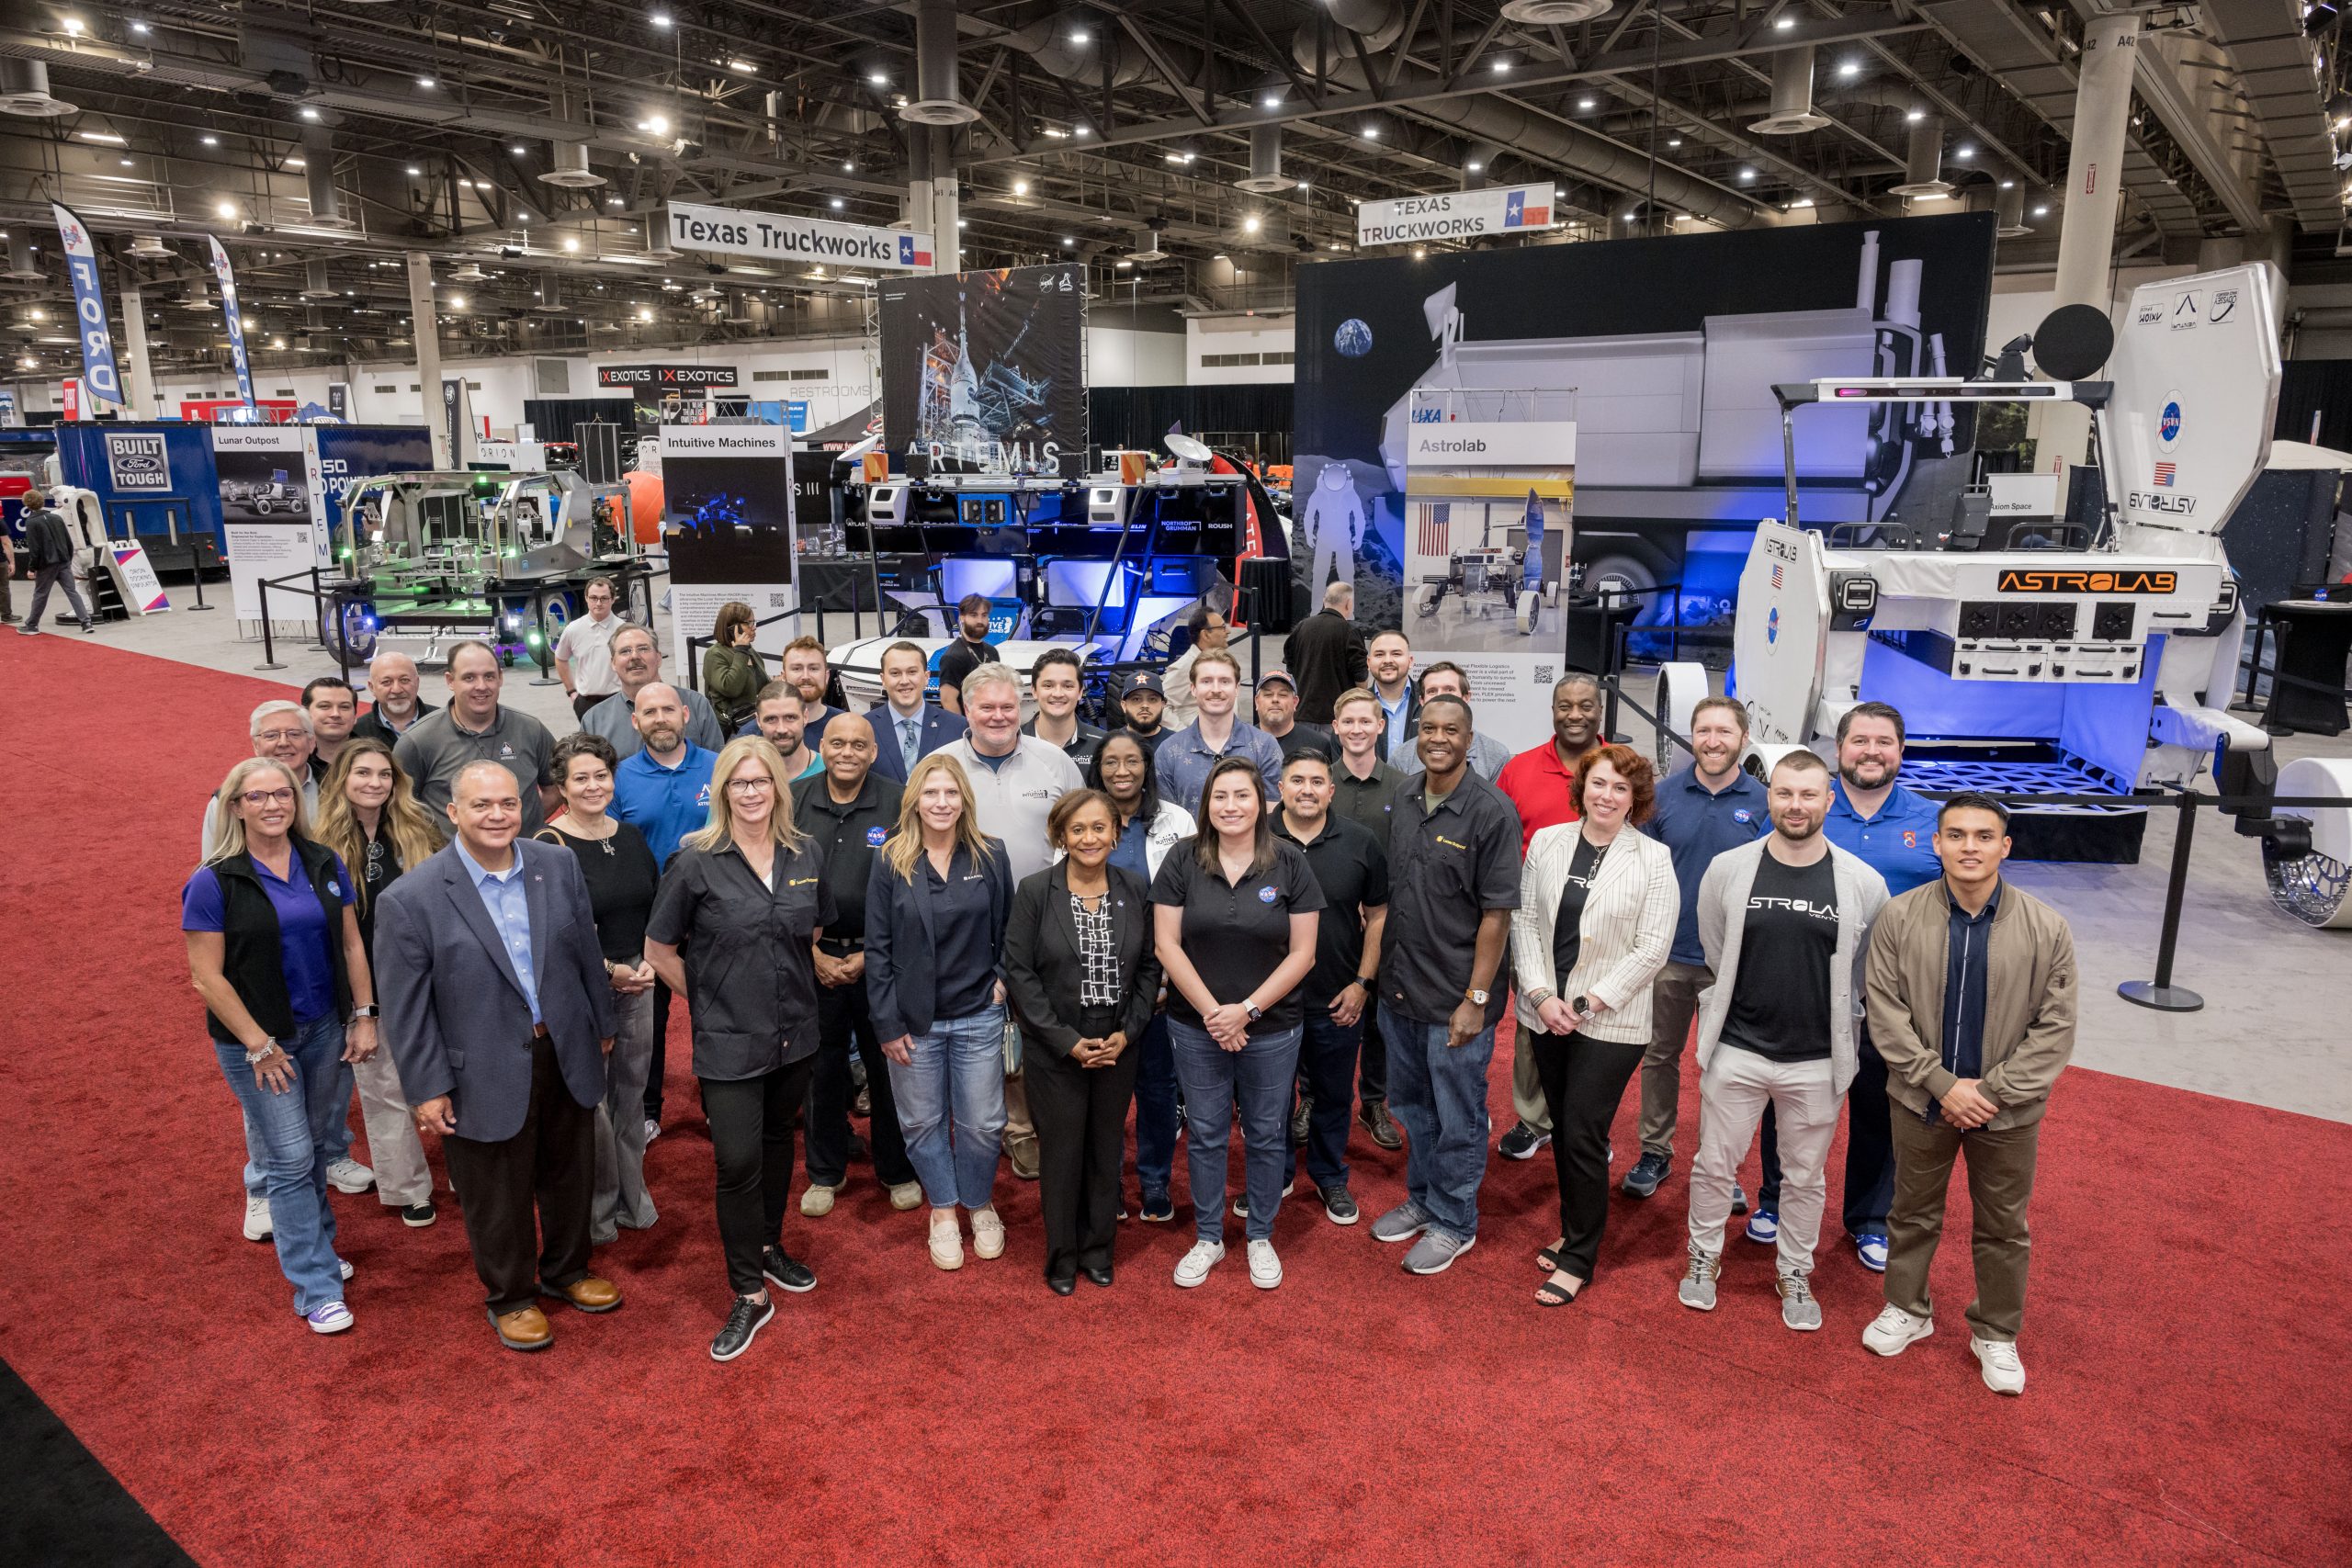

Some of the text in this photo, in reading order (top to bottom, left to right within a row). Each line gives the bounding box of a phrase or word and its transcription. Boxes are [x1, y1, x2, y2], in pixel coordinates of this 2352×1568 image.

[2117, 35, 2135, 47] A42
[1395, 196, 1451, 216] TEXAS
[673, 212, 891, 261] Texas Truckworks
[1363, 217, 1485, 243] TRUCKWORKS
[790, 385, 871, 398] RESTROOMS
[112, 439, 160, 456] BUILT
[218, 436, 279, 446] Lunar Outpost
[668, 437, 775, 448] Intuitive Machines
[1419, 438, 1487, 452] Astrolab
[127, 457, 151, 469] Ford
[322, 459, 348, 474] 50
[117, 473, 164, 486] TOUGH
[807, 481, 820, 496] III
[308, 442, 329, 557] ARTEM
[2011, 502, 2032, 512] Space
[2129, 492, 2197, 514] ASTROLAB
[1999, 571, 2176, 592] ASTROLAB
[1747, 897, 1839, 919] STROLA
